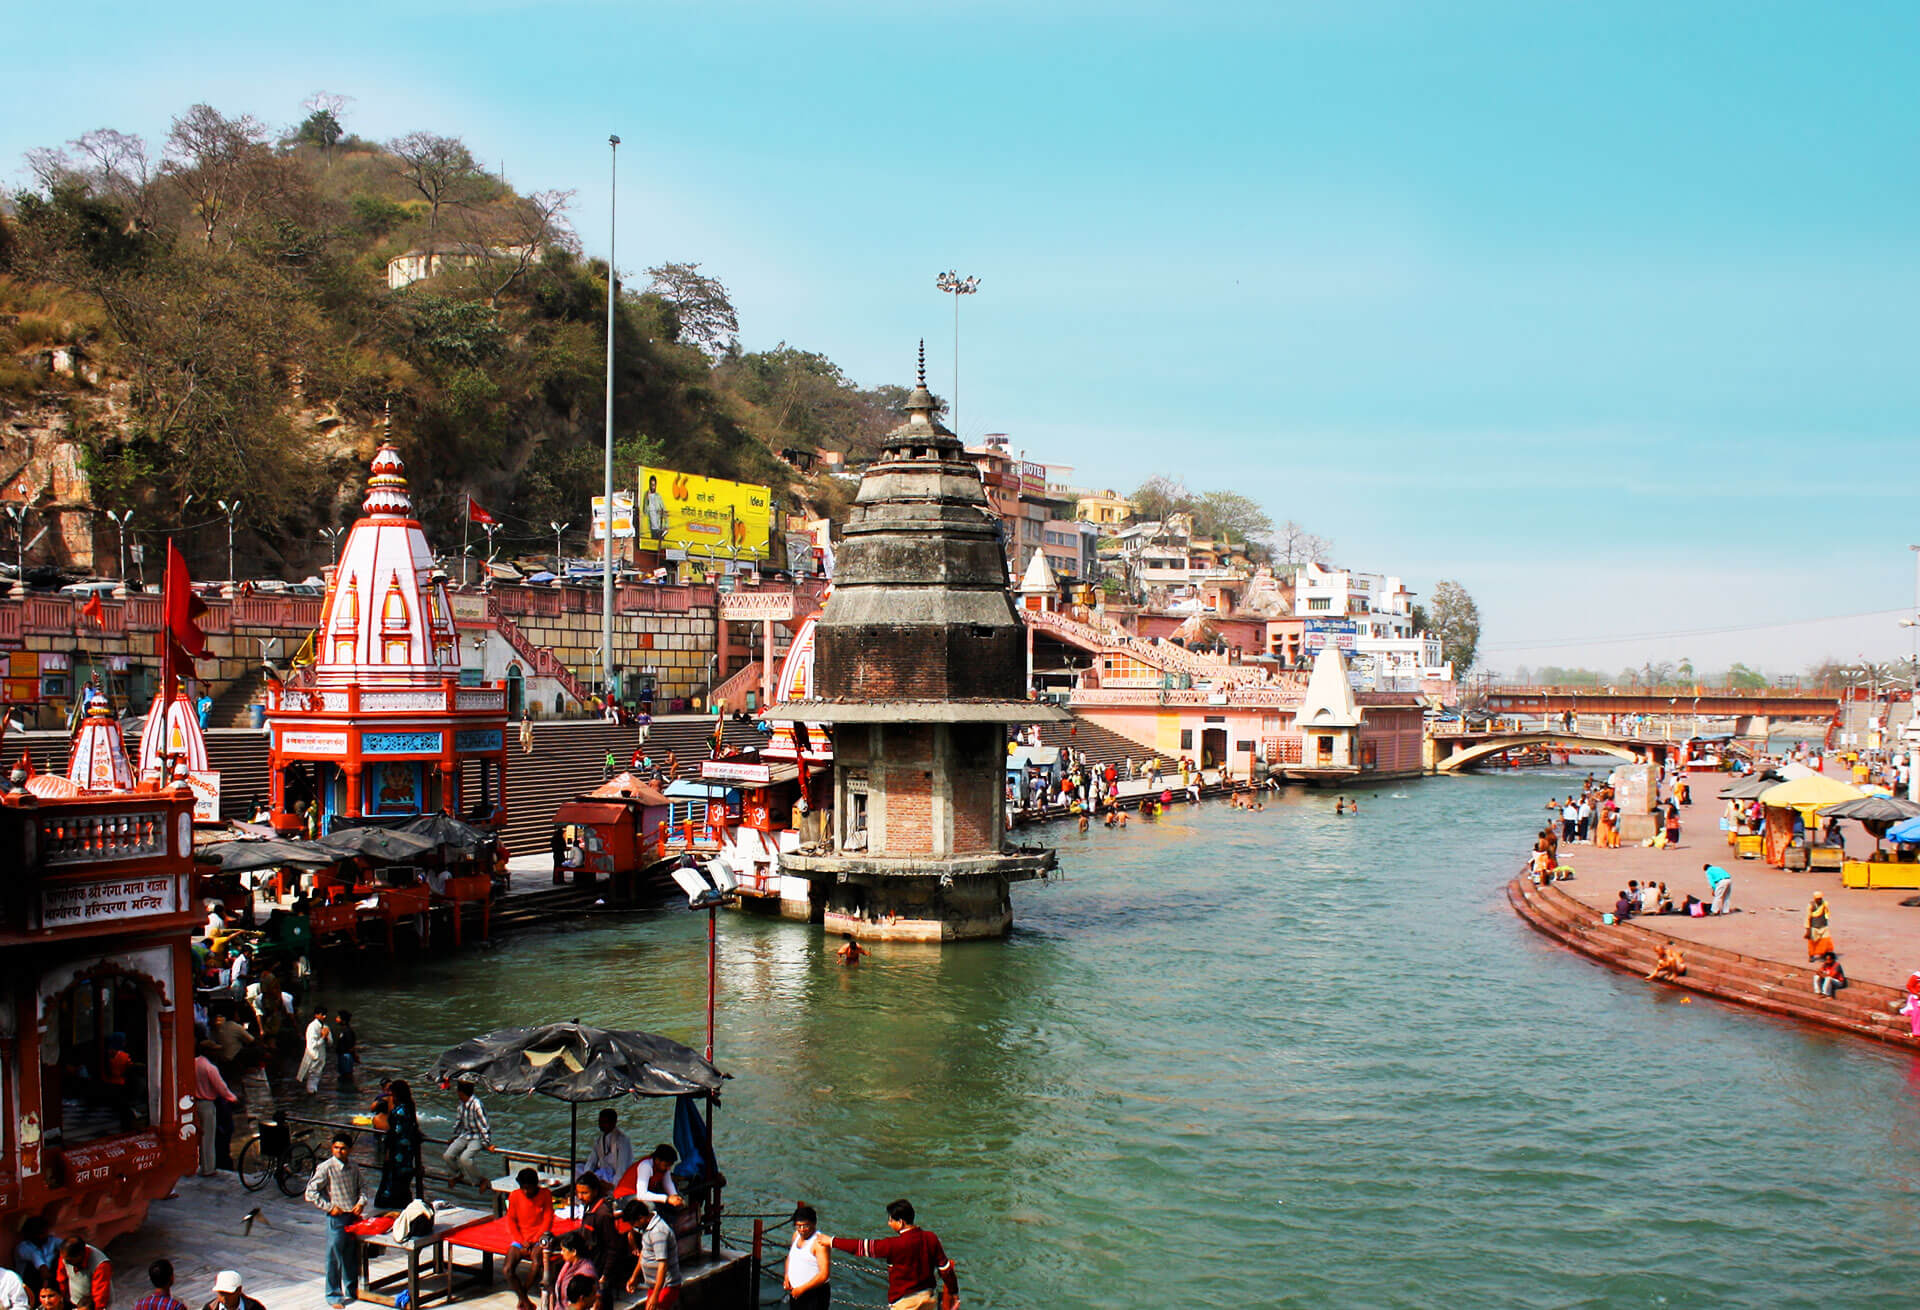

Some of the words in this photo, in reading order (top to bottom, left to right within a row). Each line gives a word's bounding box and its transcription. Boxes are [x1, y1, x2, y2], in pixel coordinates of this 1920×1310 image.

[1023, 463, 1045, 478] HOTEL
[123, 881, 145, 895] माता
[146, 879, 168, 891] राजा
[131, 895, 163, 910] मन्दिर
[75, 1170, 91, 1184] दान
